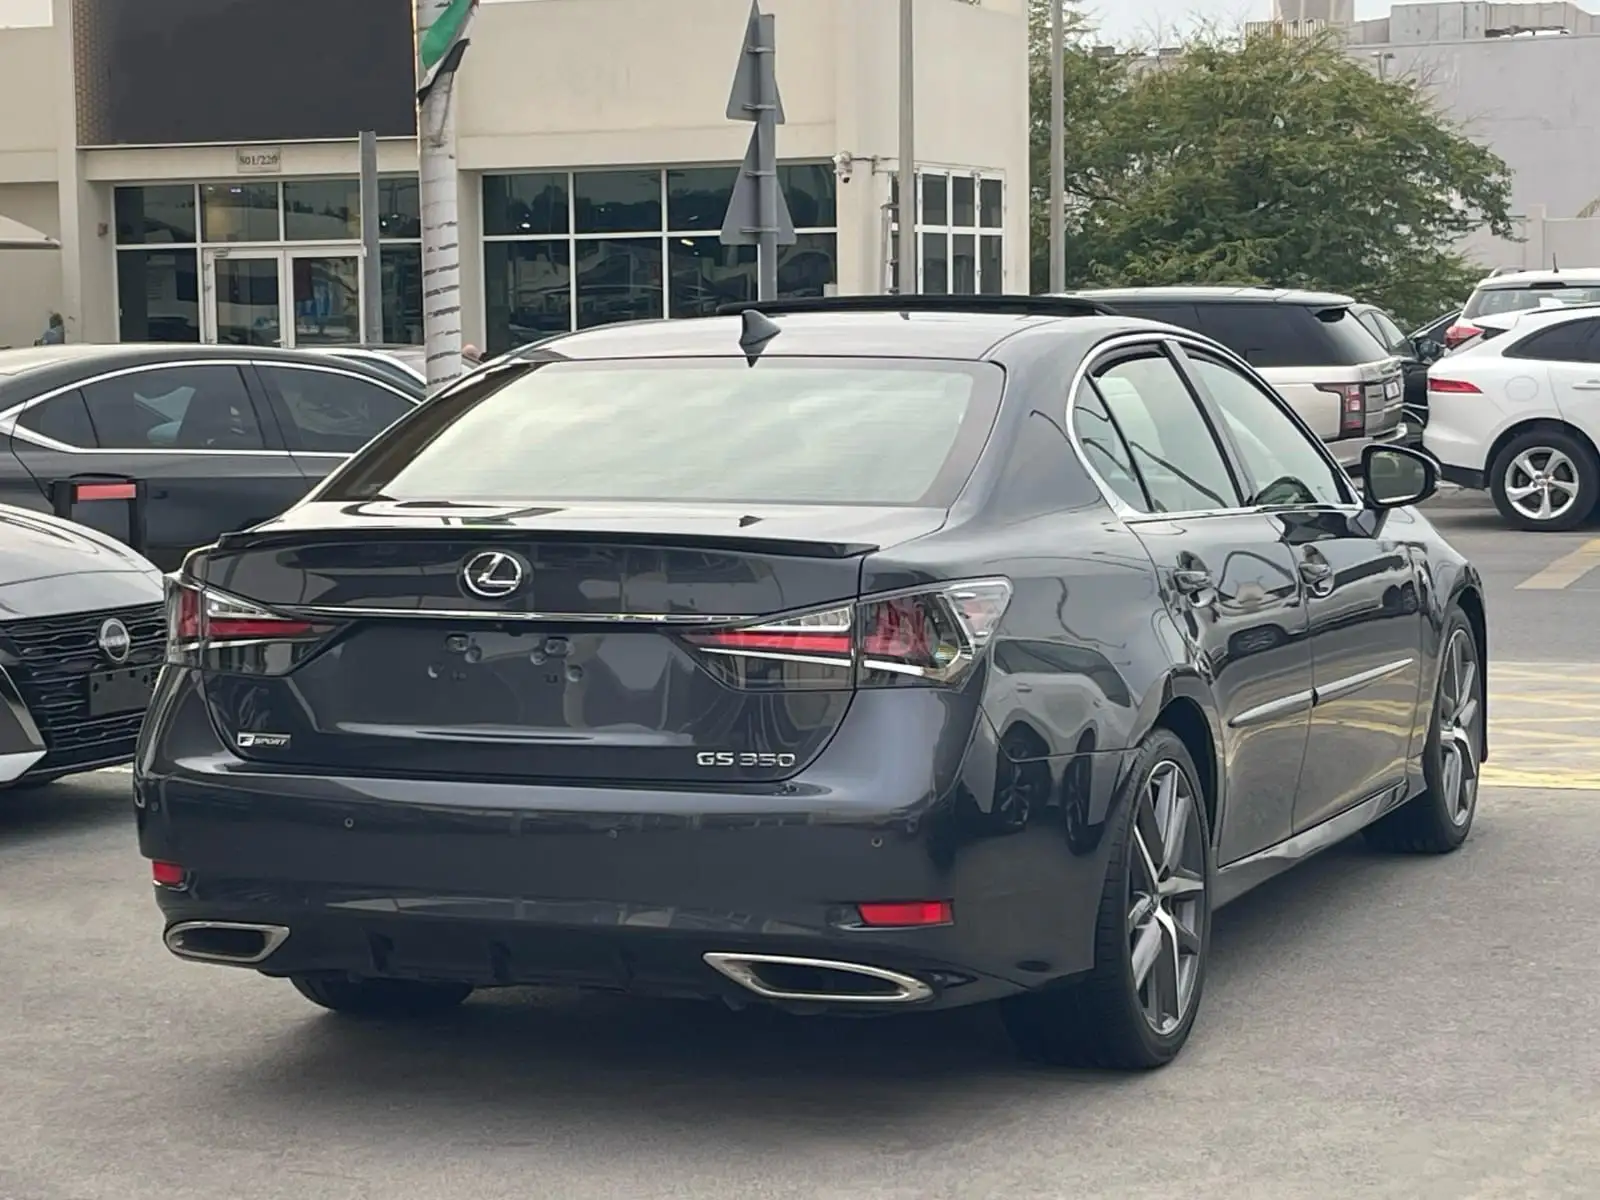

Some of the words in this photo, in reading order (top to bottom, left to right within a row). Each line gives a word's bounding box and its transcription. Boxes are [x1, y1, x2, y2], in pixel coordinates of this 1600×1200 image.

[254, 737, 287, 746] SPORT
[696, 751, 734, 766] GS
[739, 752, 796, 767] 350
